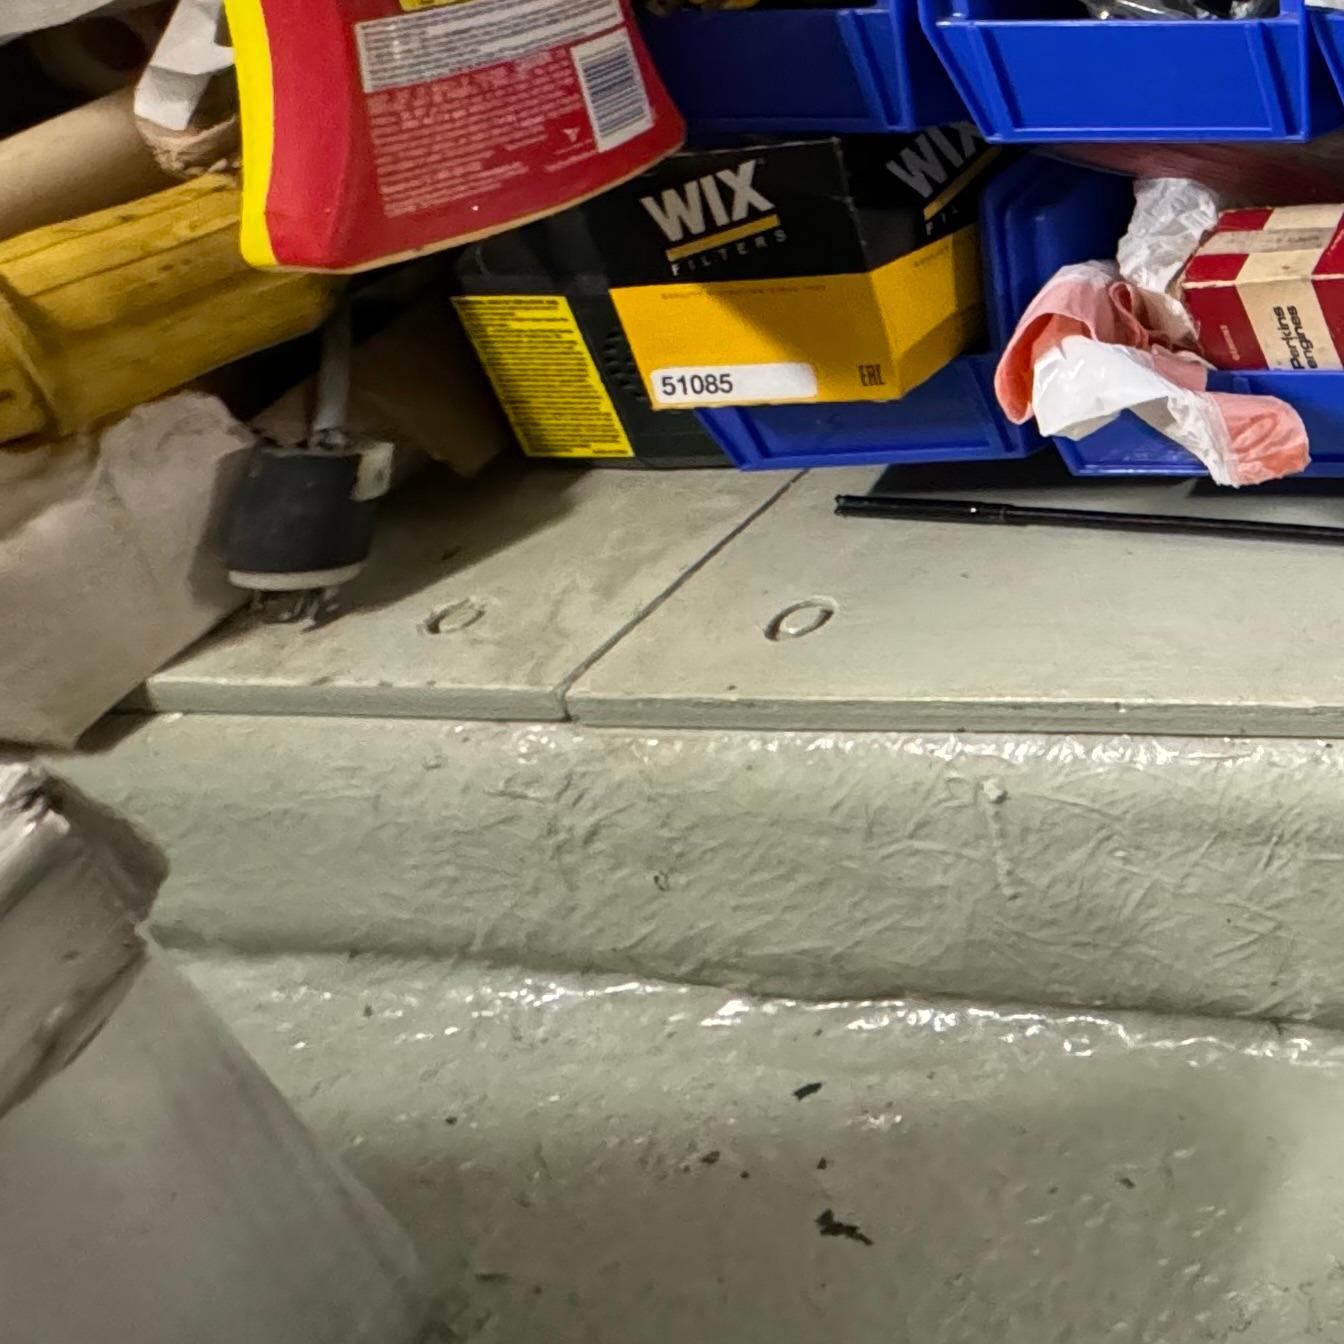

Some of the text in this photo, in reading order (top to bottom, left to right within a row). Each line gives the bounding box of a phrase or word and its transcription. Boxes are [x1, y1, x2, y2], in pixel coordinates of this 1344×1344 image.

[885, 121, 982, 199] WIX
[638, 158, 777, 244] WIX
[671, 228, 789, 277] FILTERS
[1272, 305, 1305, 370] Perkins
[1286, 305, 1318, 369] engines
[660, 373, 734, 397] 51085
